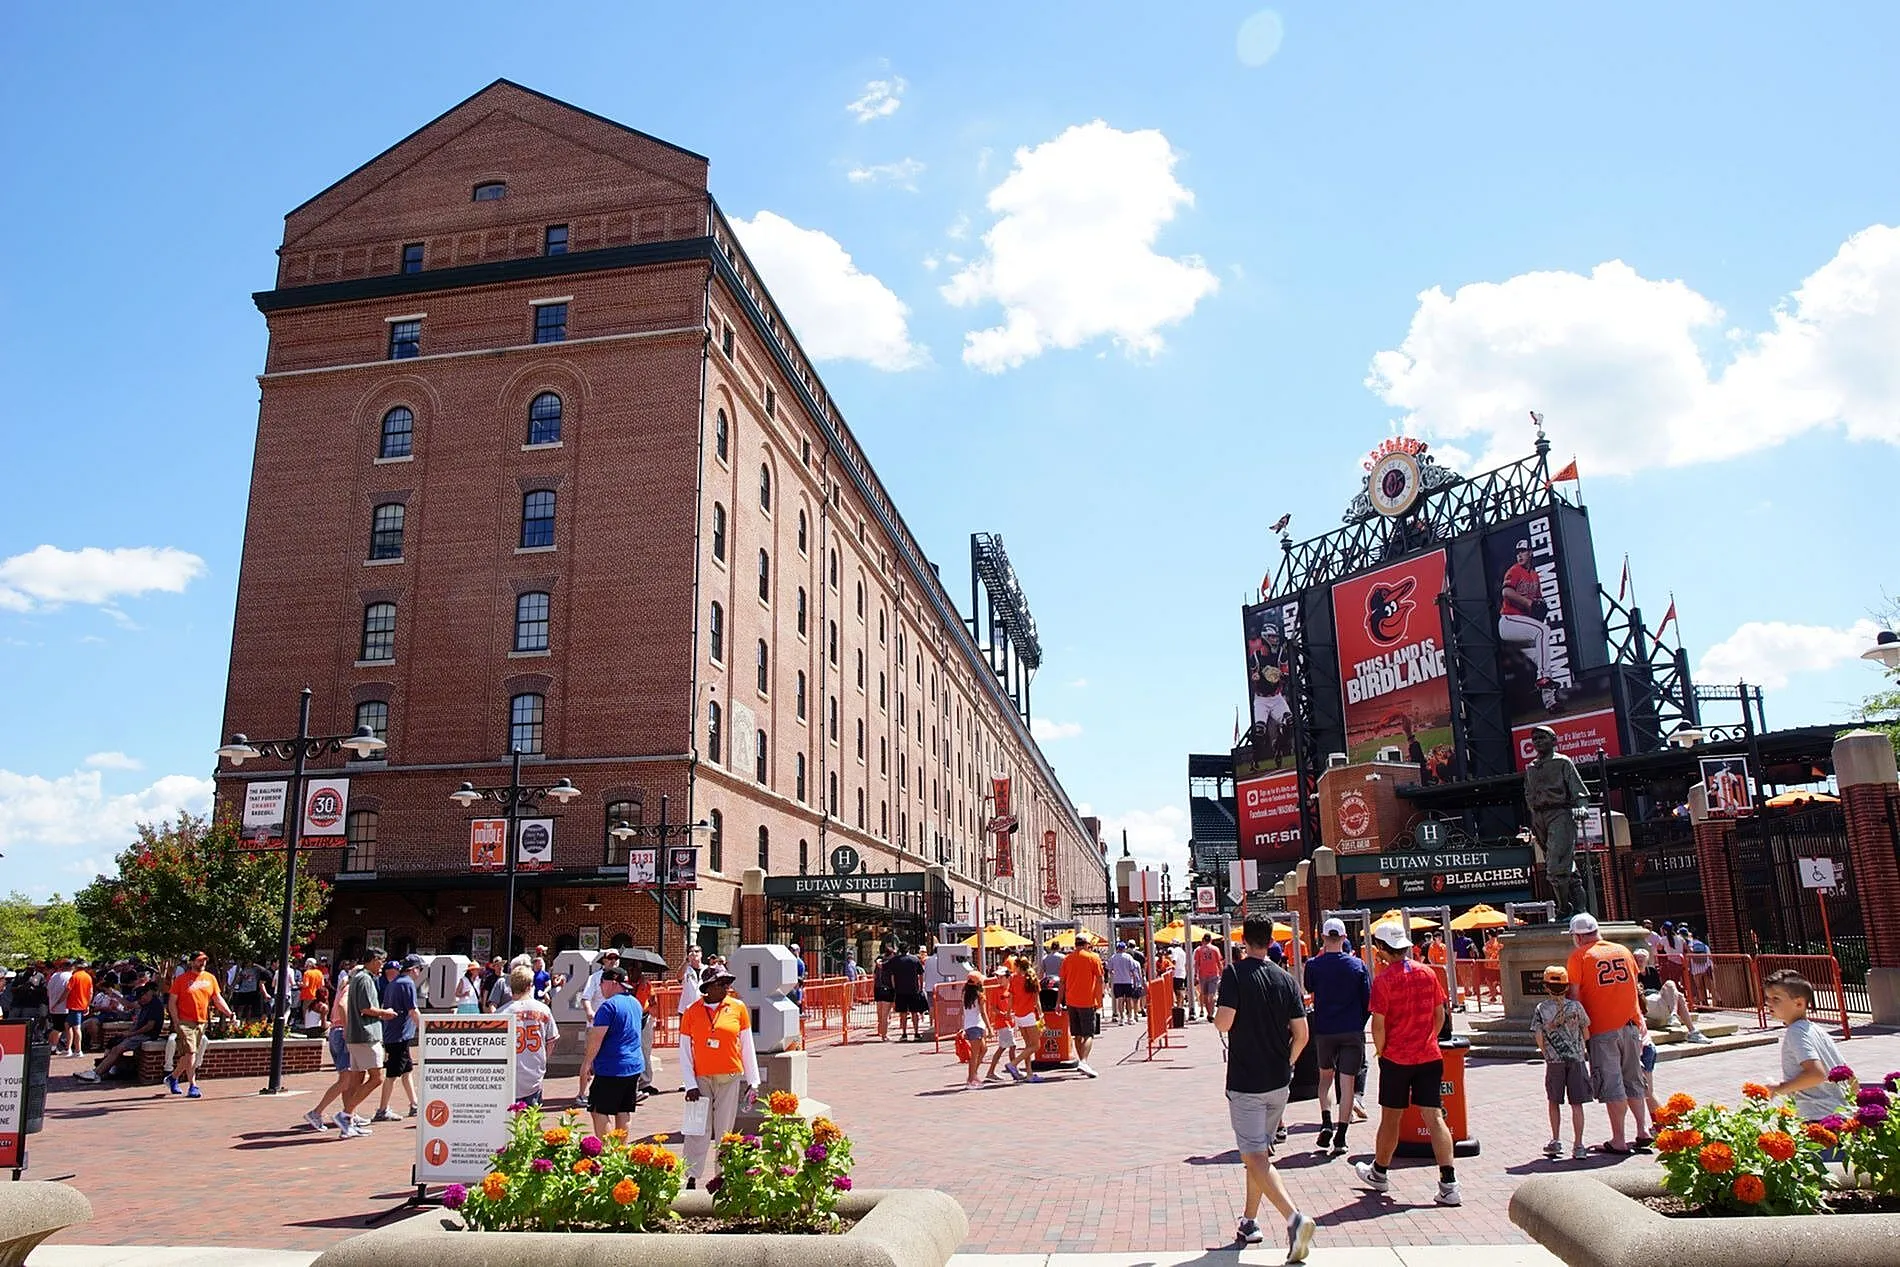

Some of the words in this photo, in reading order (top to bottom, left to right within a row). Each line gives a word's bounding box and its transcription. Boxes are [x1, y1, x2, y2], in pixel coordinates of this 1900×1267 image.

[1529, 516, 1554, 557] GET
[1354, 656, 1387, 678] THIS
[1385, 643, 1420, 668] LAND
[1421, 637, 1435, 656] IS
[316, 797, 334, 813] 30
[1423, 824, 1438, 841] H
[838, 850, 850, 865] H
[1380, 855, 1432, 871] EUTAW
[1434, 852, 1490, 868] STREET
[796, 878, 844, 892] EUTAW
[846, 877, 897, 890] STREET
[1446, 868, 1523, 885] BLEACHER
[1596, 957, 1631, 987] 25
[425, 1037, 450, 1046] FOOD
[450, 1037, 457, 1046] &
[459, 1036, 507, 1046] BEVERAGE
[450, 1047, 482, 1056] POLICY
